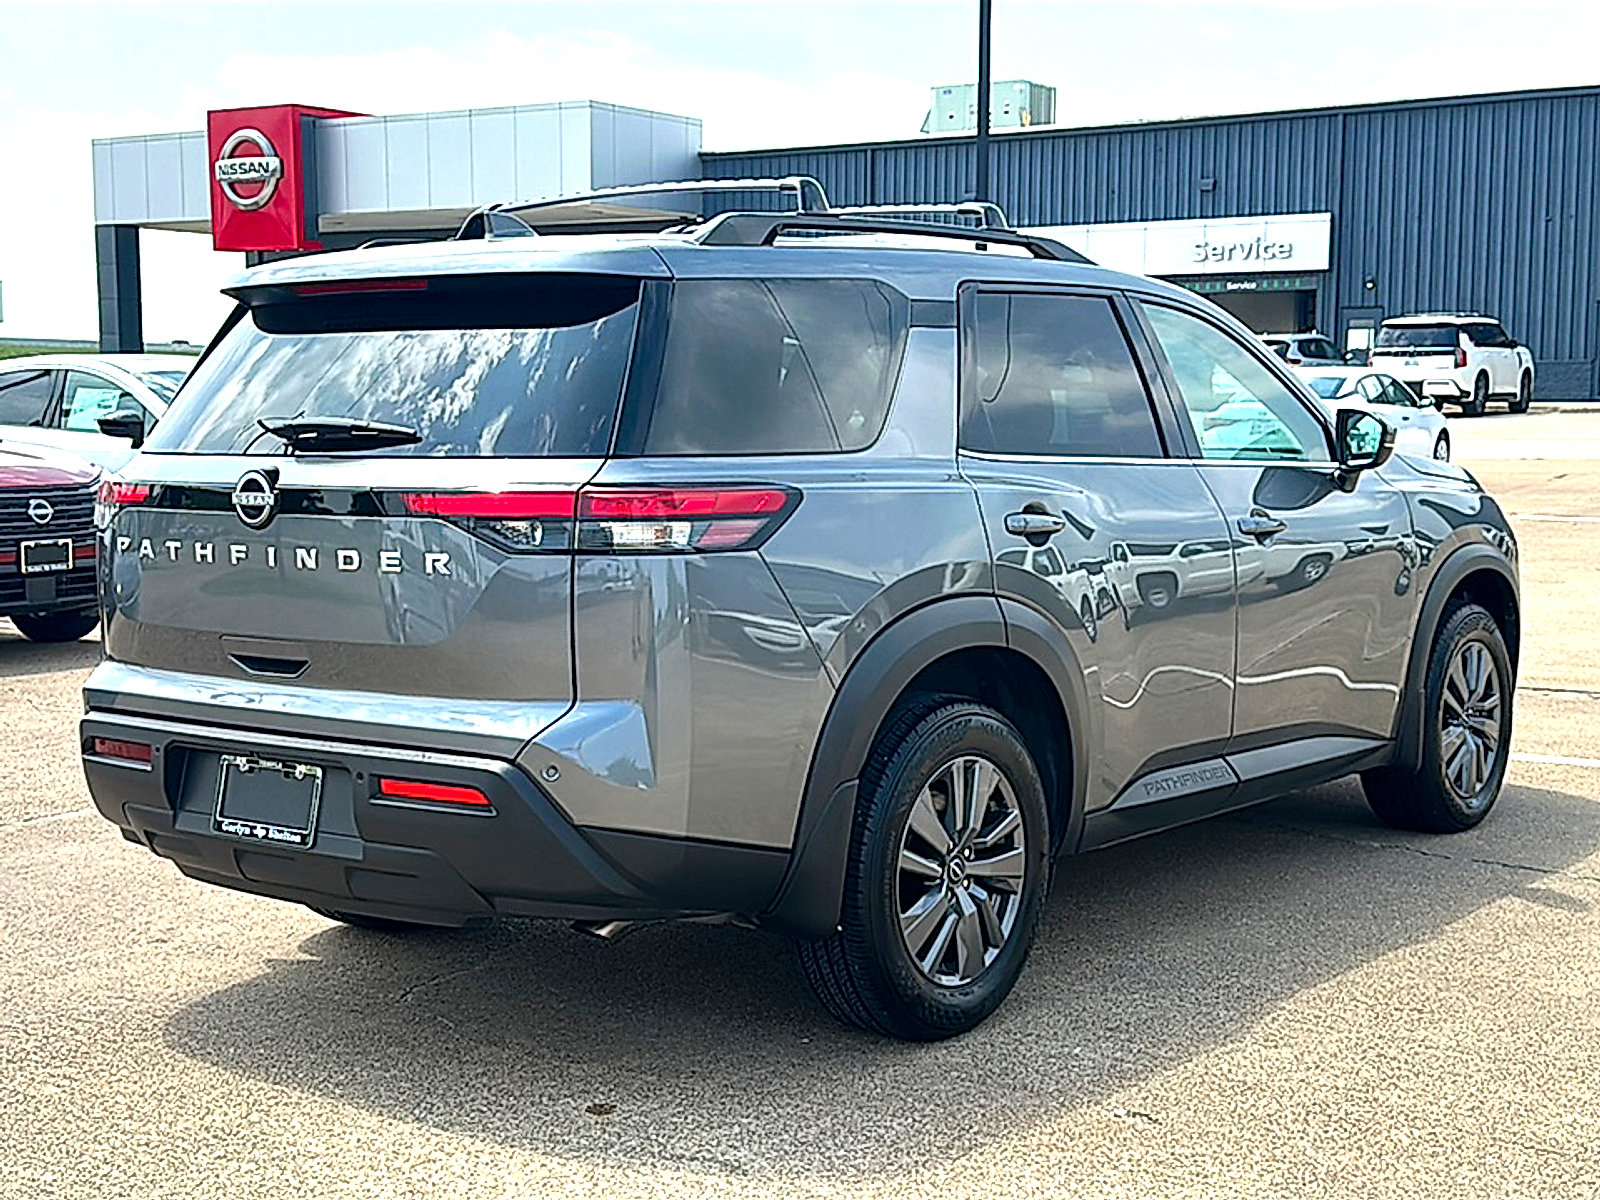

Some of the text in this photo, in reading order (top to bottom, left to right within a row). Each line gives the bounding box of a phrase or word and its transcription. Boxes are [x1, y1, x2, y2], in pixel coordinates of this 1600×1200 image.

[218, 161, 271, 176] NISSAN
[1191, 236, 1293, 262] Service
[115, 535, 452, 575] PATHFINDER
[1143, 764, 1232, 796] PATHFINDER
